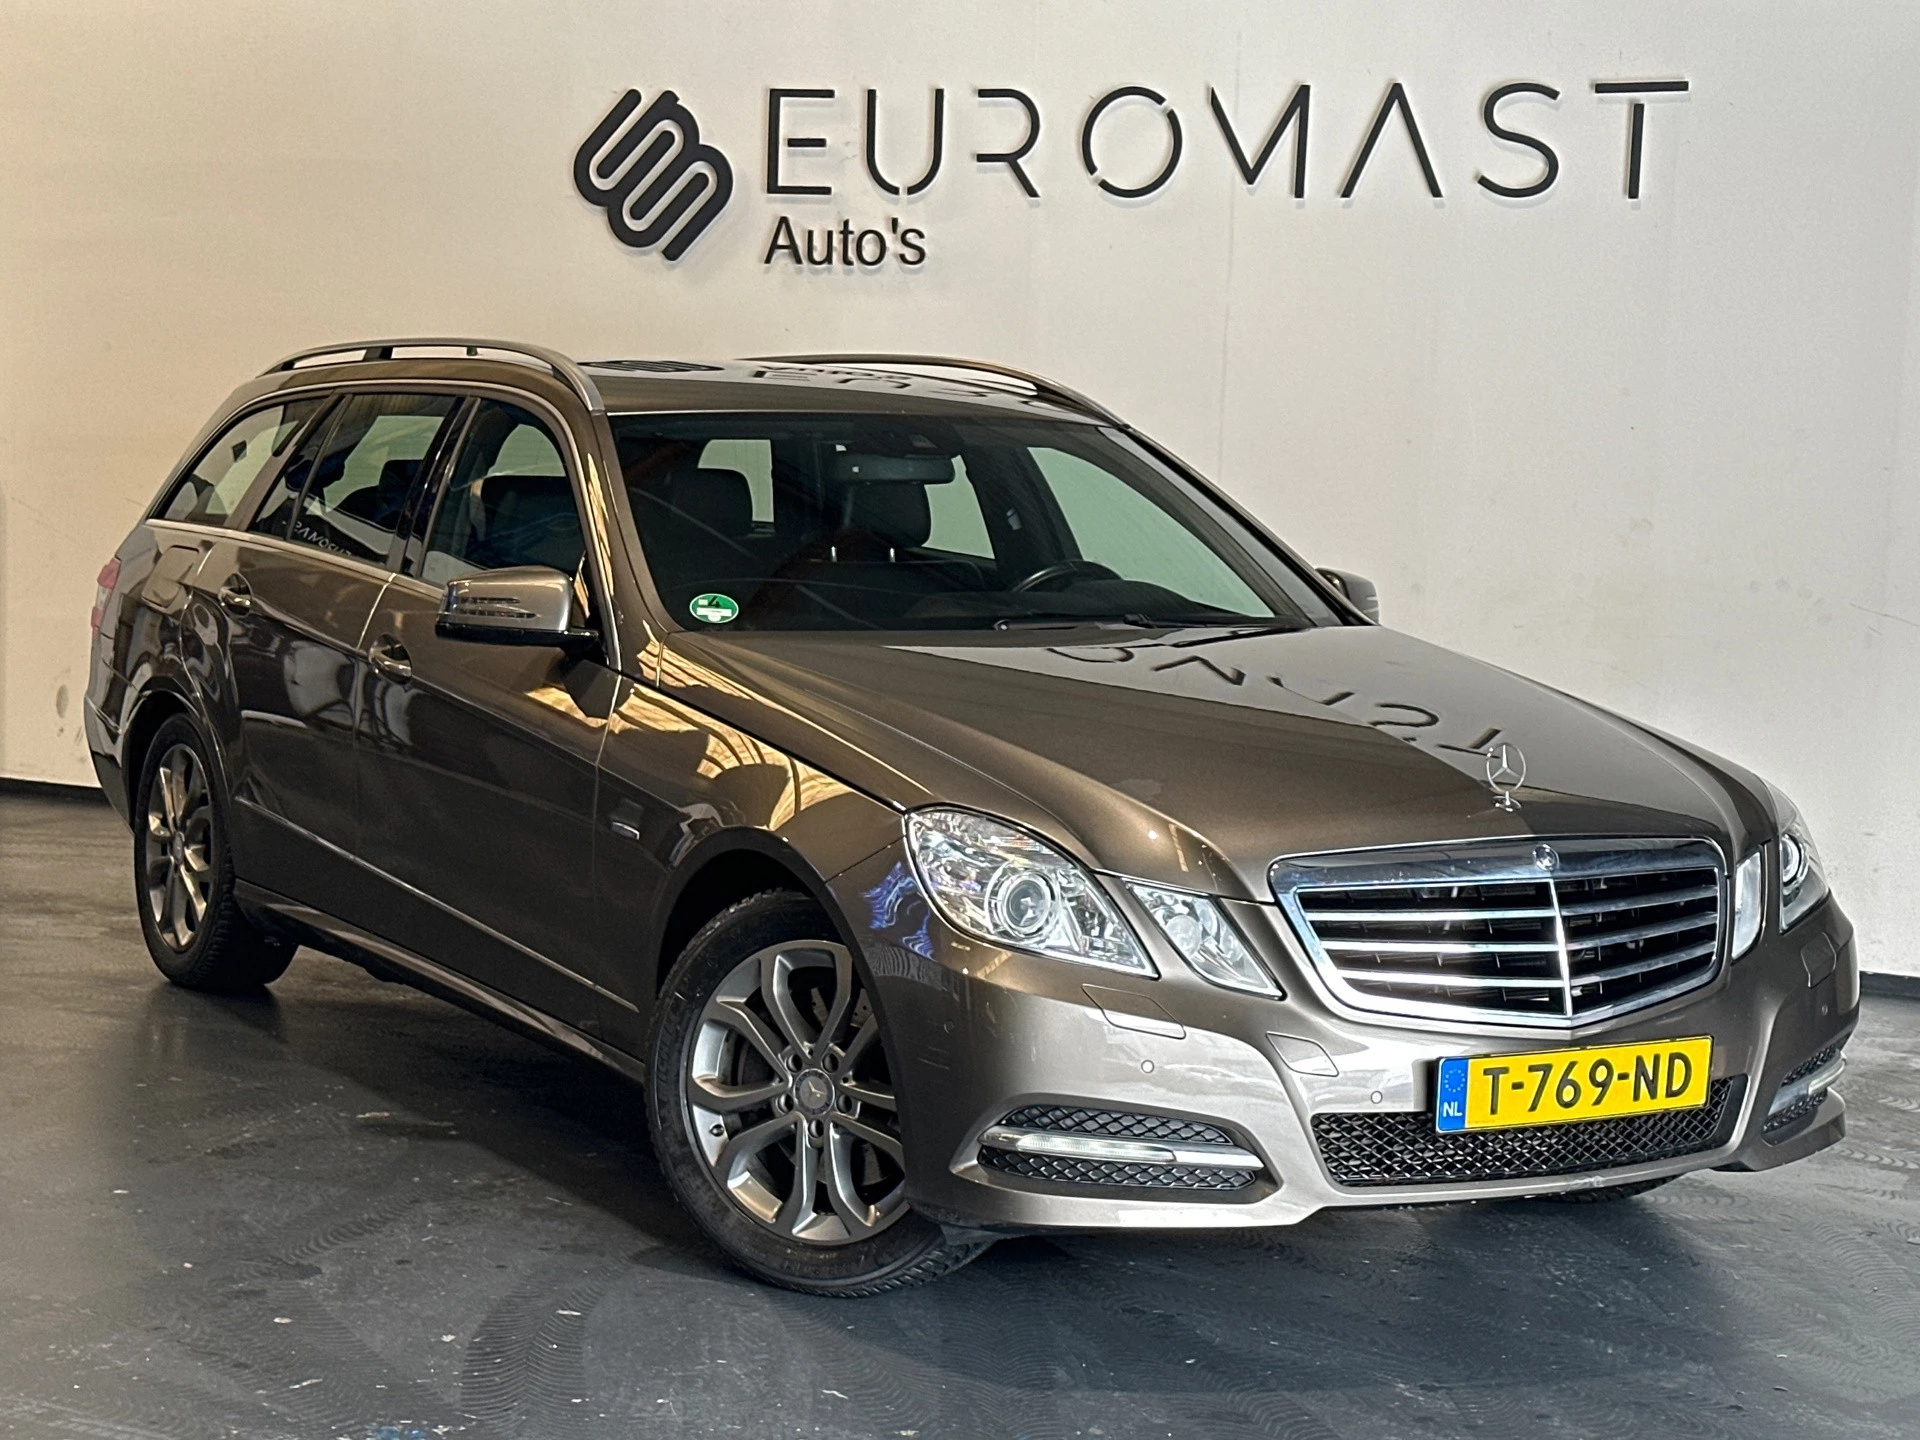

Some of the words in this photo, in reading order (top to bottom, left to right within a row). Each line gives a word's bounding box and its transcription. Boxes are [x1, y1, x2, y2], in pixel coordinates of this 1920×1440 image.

[766, 81, 1689, 199] EUROMAST
[763, 215, 927, 267] Auto's
[1442, 1101, 1463, 1118] NL
[1482, 1051, 1693, 1116] T-769-ND
